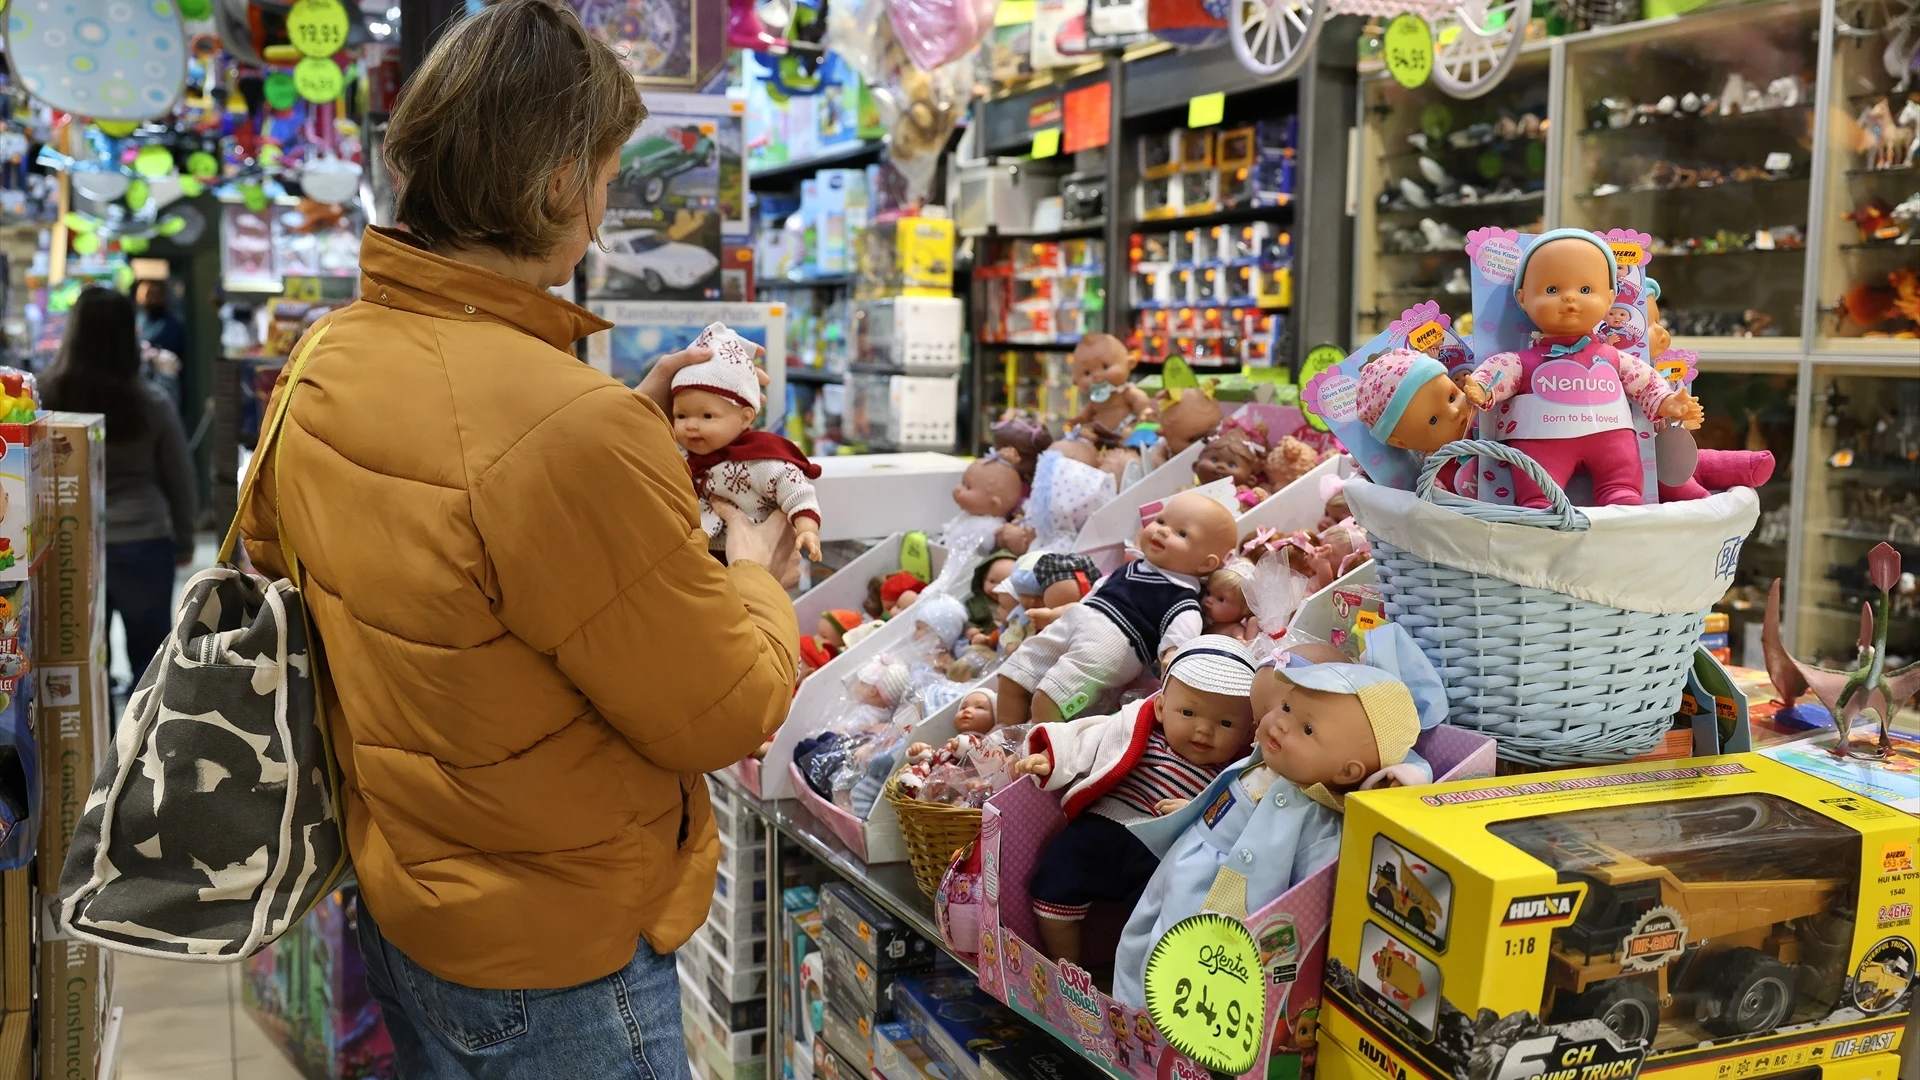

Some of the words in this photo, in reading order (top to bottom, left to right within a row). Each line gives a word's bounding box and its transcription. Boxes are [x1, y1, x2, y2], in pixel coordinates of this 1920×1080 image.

[1485, 246, 1501, 256] Gives
[1487, 260, 1496, 268] Da
[1416, 327, 1437, 344] OFERTA
[1322, 390, 1338, 400] Gives
[1338, 383, 1355, 393] Kisses
[1538, 375, 1616, 393] Nenuco
[1543, 414, 1564, 423] Born
[1568, 414, 1577, 422] to
[1581, 413, 1592, 422] be
[1596, 413, 1619, 424] loved
[57, 475, 79, 505] Kit
[58, 515, 81, 655] Construcción
[59, 711, 81, 740] Kit
[1422, 796, 1440, 807] 6
[1439, 786, 1520, 805] CHANNEL
[1515, 781, 1558, 796] FULL
[1556, 772, 1650, 791] FUNCTIONAL
[1878, 876, 1890, 884] HUI
[1890, 888, 1906, 896] 1540
[1509, 896, 1571, 920] HUINA
[1877, 902, 1913, 920] 2.4GHz
[1645, 921, 1671, 932] SUPER
[1505, 937, 1536, 956] 1:18
[1632, 934, 1677, 952] DIE-CAST
[66, 940, 88, 969] Kit
[1199, 945, 1249, 980] Oferta
[1860, 942, 1889, 973] POWERFUL
[1891, 941, 1909, 953] TRUCK
[1061, 963, 1092, 995] CRY
[1058, 976, 1100, 1017] Babies
[1173, 978, 1254, 1052] 24,95
[1562, 1044, 1597, 1067] CH
[1831, 1032, 1896, 1059] DIE-CAST
[1359, 1037, 1406, 1080] HUINA
[1581, 1058, 1637, 1080] TRUCK
[1719, 1064, 1731, 1074] 8+
